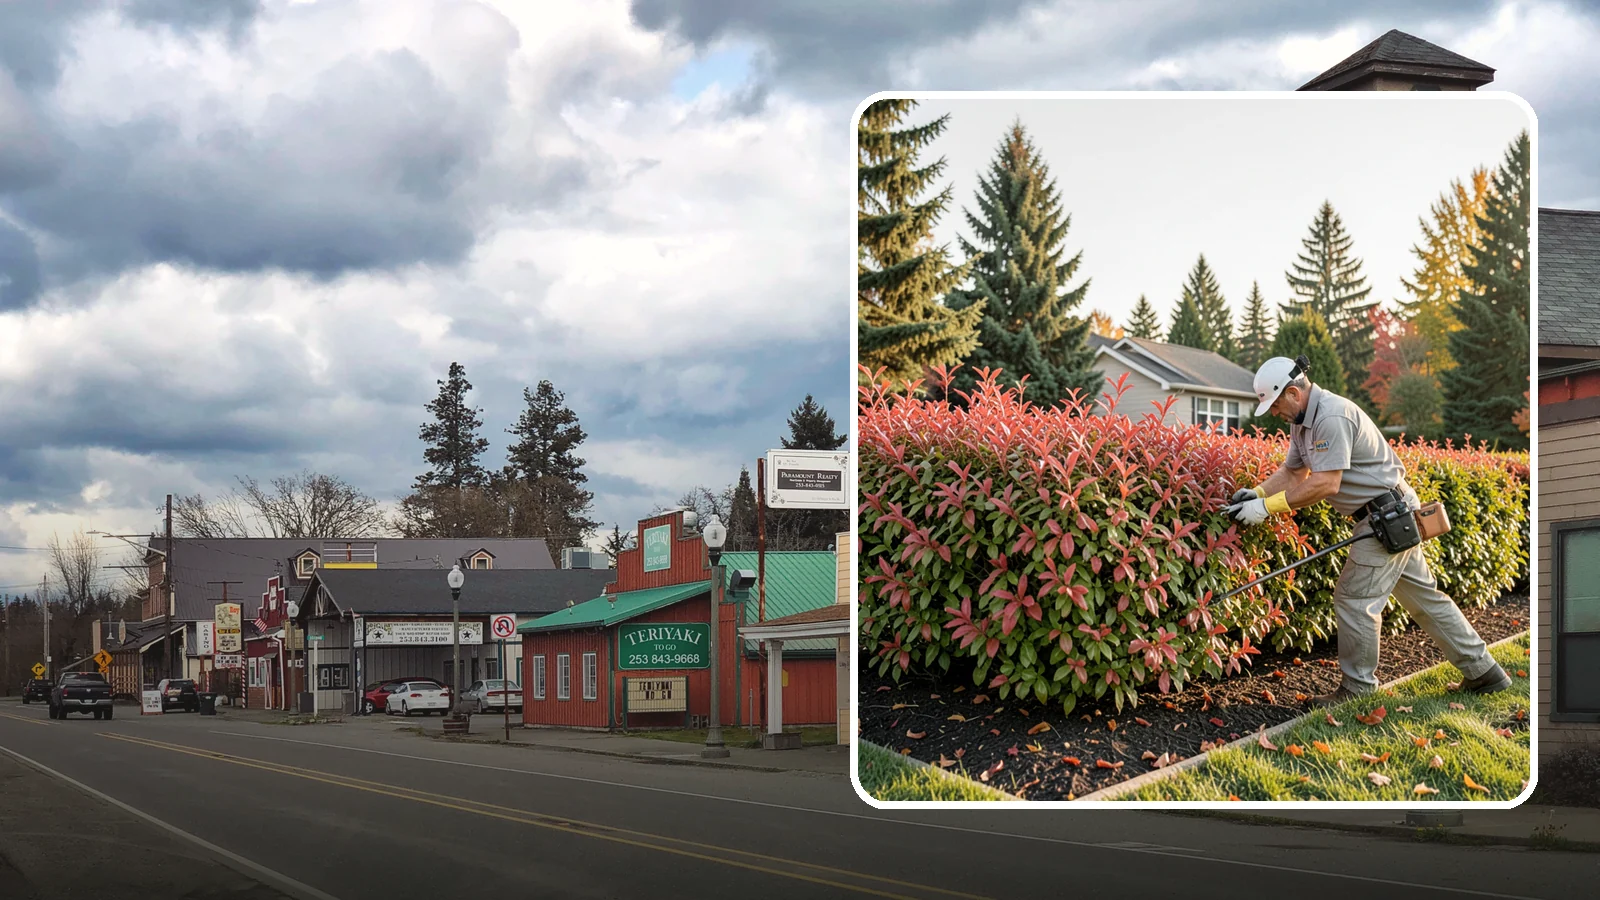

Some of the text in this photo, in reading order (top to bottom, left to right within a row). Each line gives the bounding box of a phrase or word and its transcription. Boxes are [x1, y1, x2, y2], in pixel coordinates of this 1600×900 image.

[781, 471, 839, 480] PARAMOUNT REALTY
[625, 627, 702, 645] TERIYAKI
[629, 654, 700, 664] 253 843-9668
[639, 681, 672, 691] TERIYAKI
